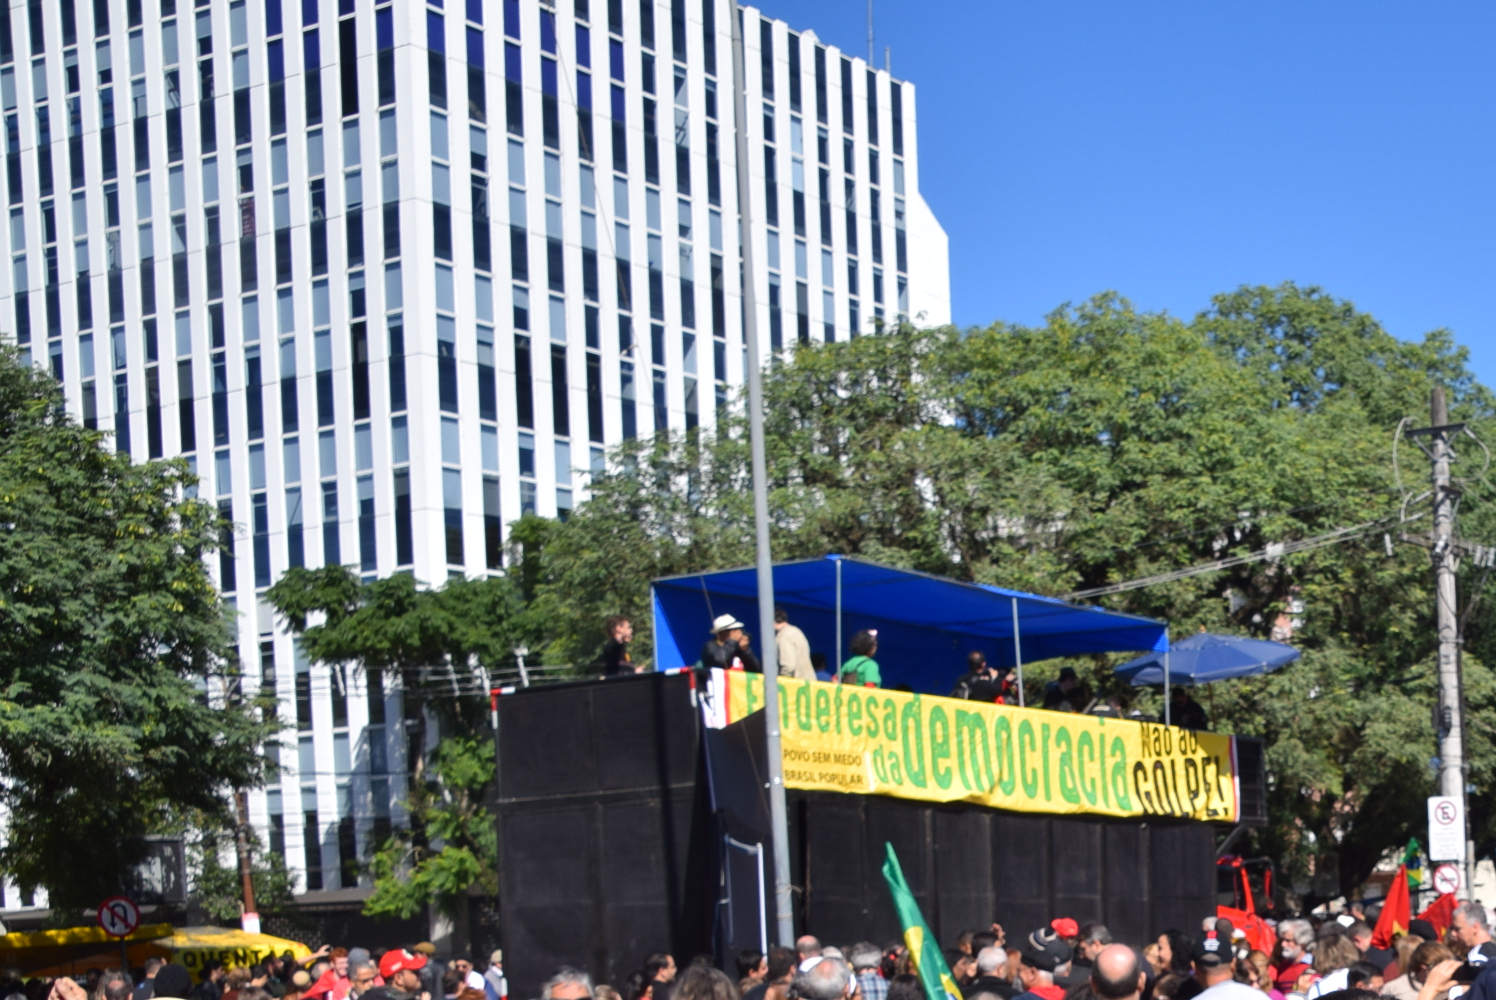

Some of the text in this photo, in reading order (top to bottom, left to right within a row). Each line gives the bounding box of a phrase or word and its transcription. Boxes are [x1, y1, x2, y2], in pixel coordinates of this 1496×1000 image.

[795, 680, 898, 741] defesa
[783, 748, 862, 767] POVO SEM MEDO
[873, 693, 1133, 811] da democracia
[784, 769, 863, 786] BRASIL POPULAR
